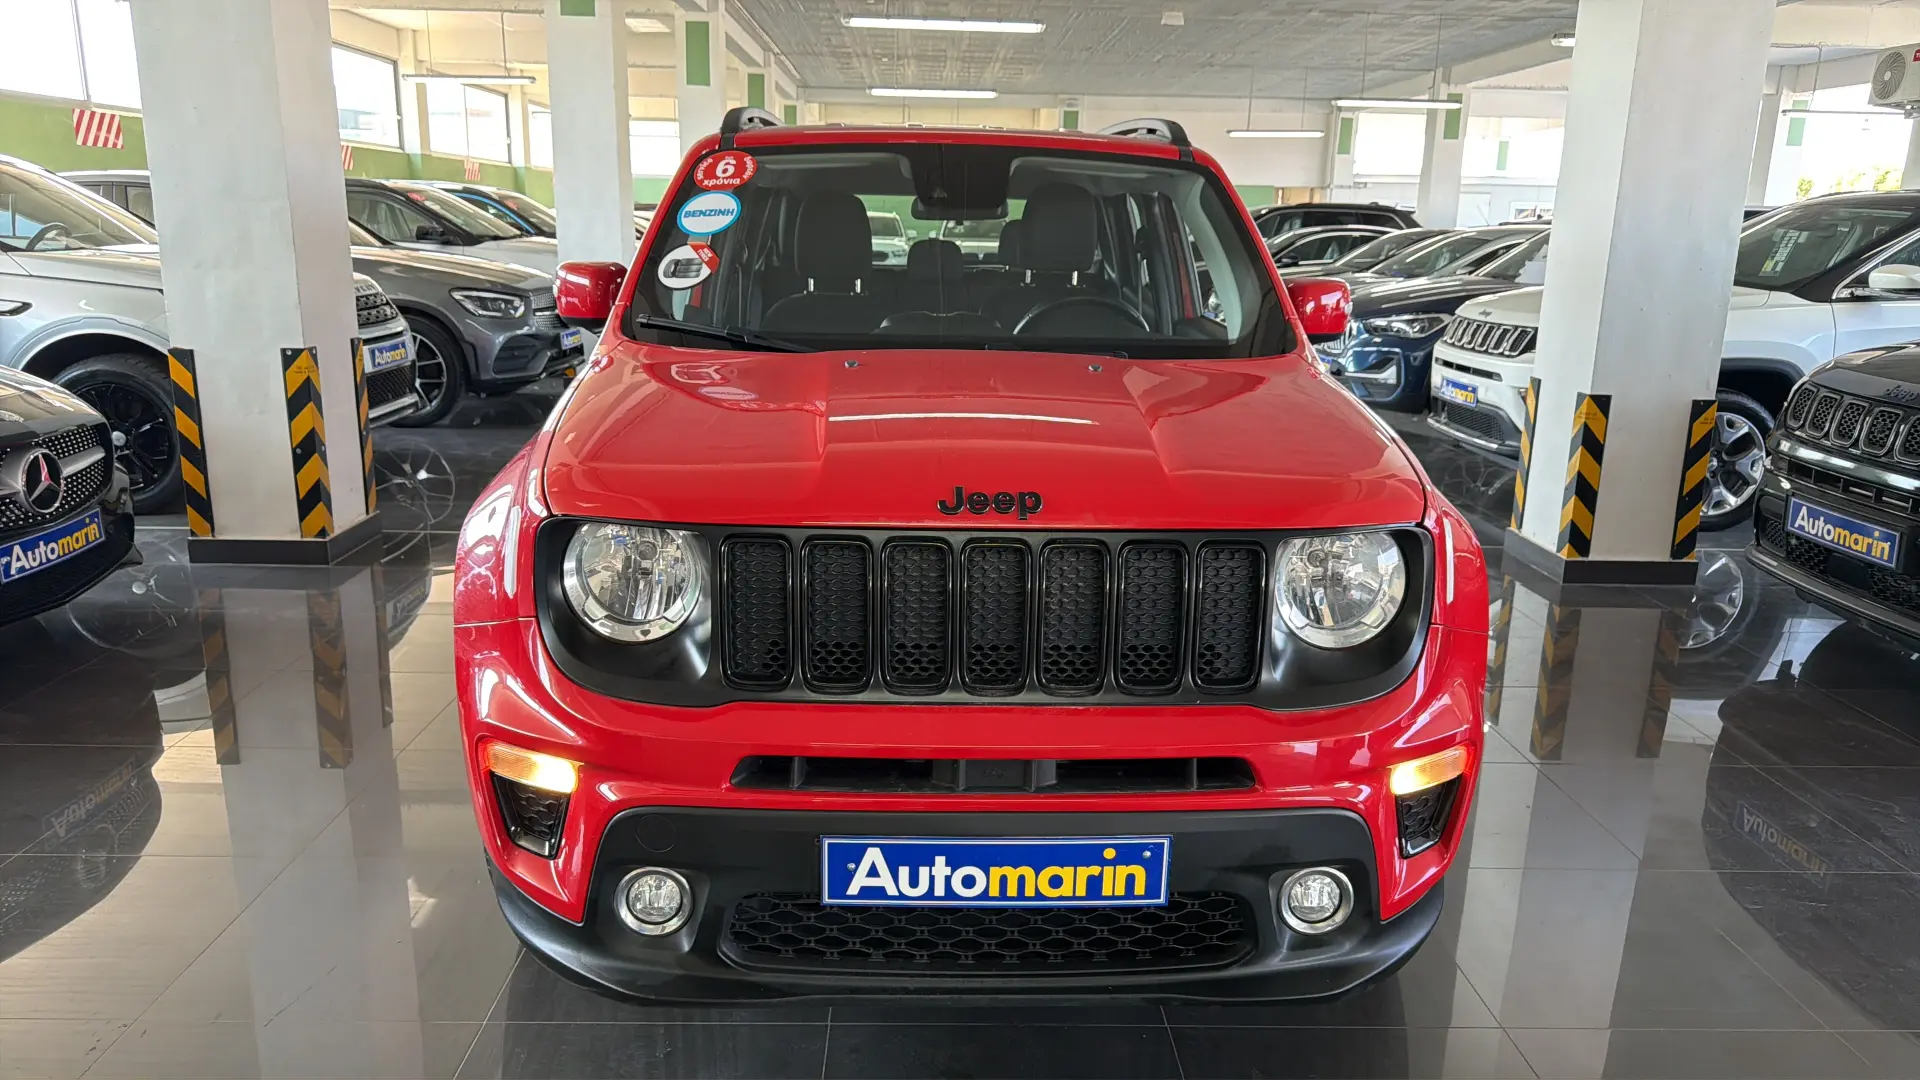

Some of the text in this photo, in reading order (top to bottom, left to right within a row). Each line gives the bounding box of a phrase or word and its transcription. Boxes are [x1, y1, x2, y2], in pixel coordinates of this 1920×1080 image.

[702, 177, 741, 187] χρόνια
[715, 158, 737, 178] 6
[937, 486, 1043, 520] Jeep
[10, 517, 99, 575] Automarin
[1794, 505, 1891, 560] Automarin
[846, 847, 1146, 897] Automarin
